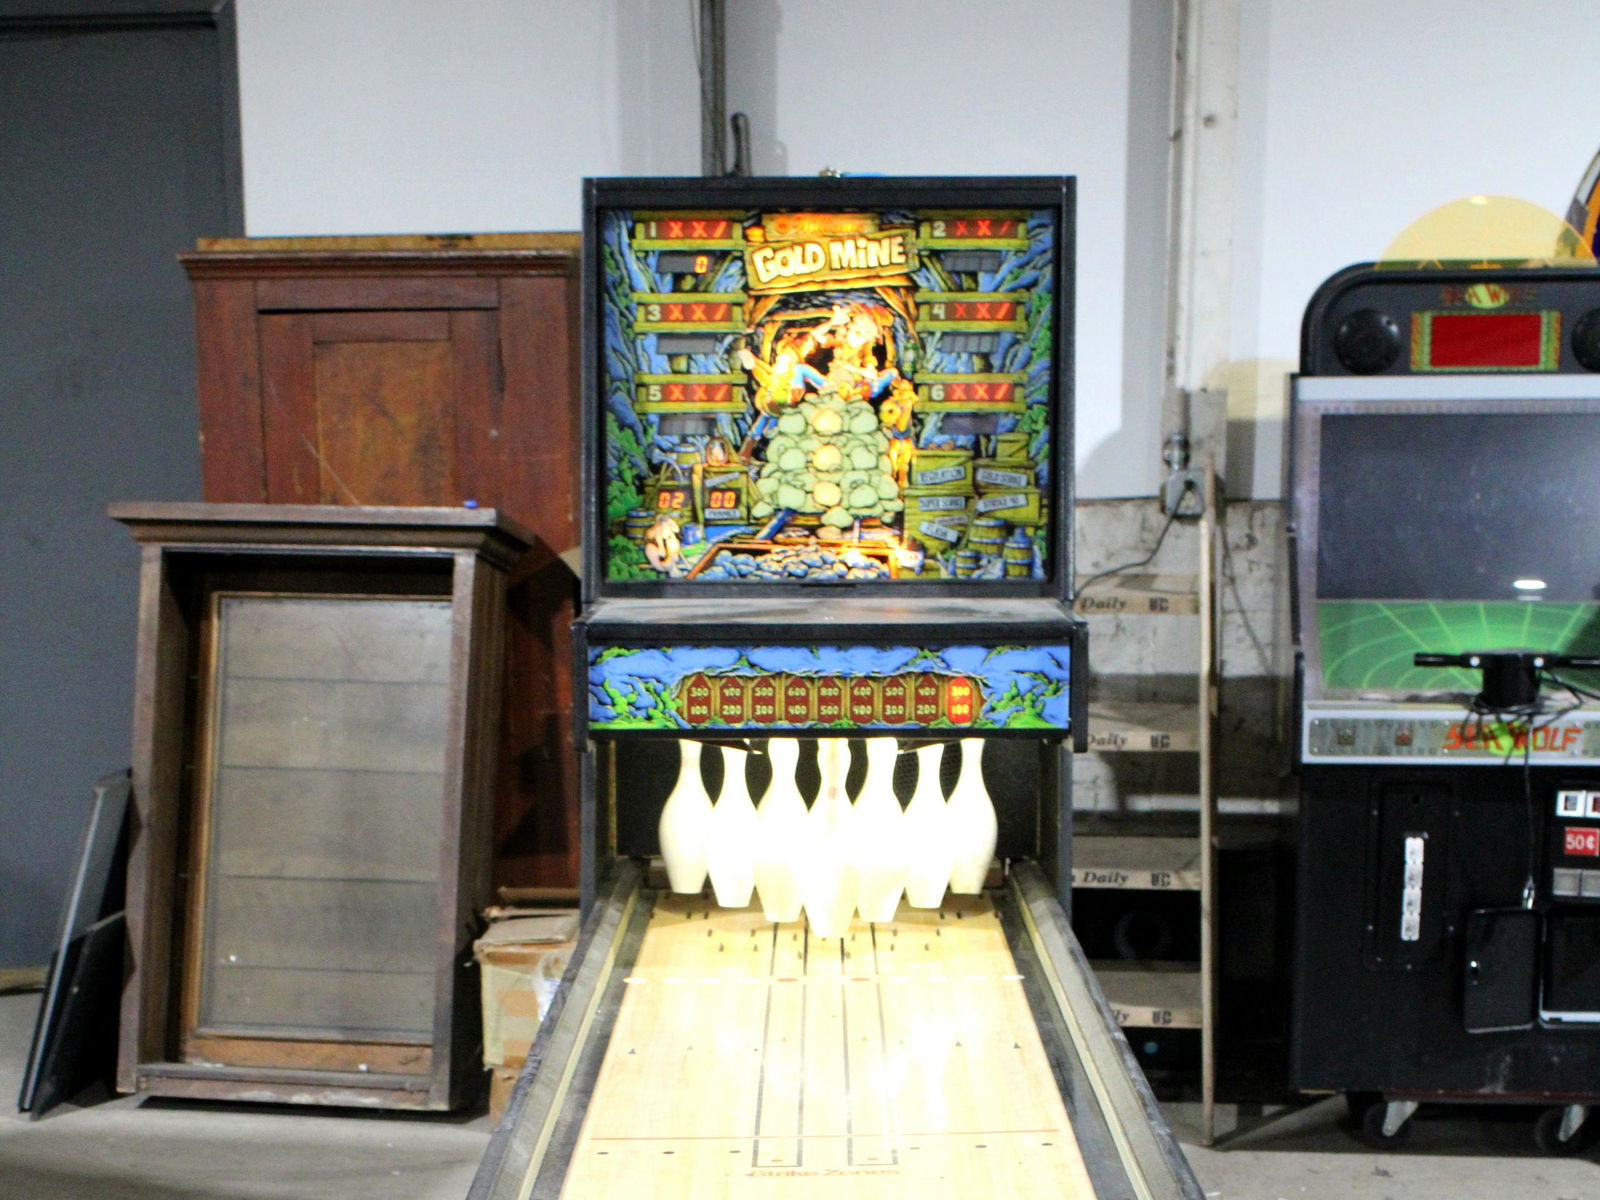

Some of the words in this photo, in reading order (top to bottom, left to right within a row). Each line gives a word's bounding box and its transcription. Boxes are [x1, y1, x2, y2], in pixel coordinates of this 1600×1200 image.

[650, 221, 657, 238] 1
[932, 220, 947, 237] 2
[752, 241, 826, 283] GOLD
[647, 304, 661, 321] 3
[932, 303, 945, 320] 4
[648, 384, 662, 401] 5
[930, 384, 945, 401] 6
[658, 490, 685, 509] 02
[1080, 596, 1128, 612] Daily
[690, 687, 709, 697] 300
[755, 687, 774, 697] 500
[788, 687, 807, 697] 600
[885, 687, 904, 697] 500
[691, 705, 709, 715] 100
[722, 705, 742, 715] 200
[755, 705, 774, 715] 300
[820, 705, 839, 715] 500
[885, 705, 904, 715] 300
[917, 704, 937, 715] 200
[1084, 871, 1129, 887] Daily
[747, 1169, 819, 1177] Strike
[823, 1169, 901, 1177] Zones
